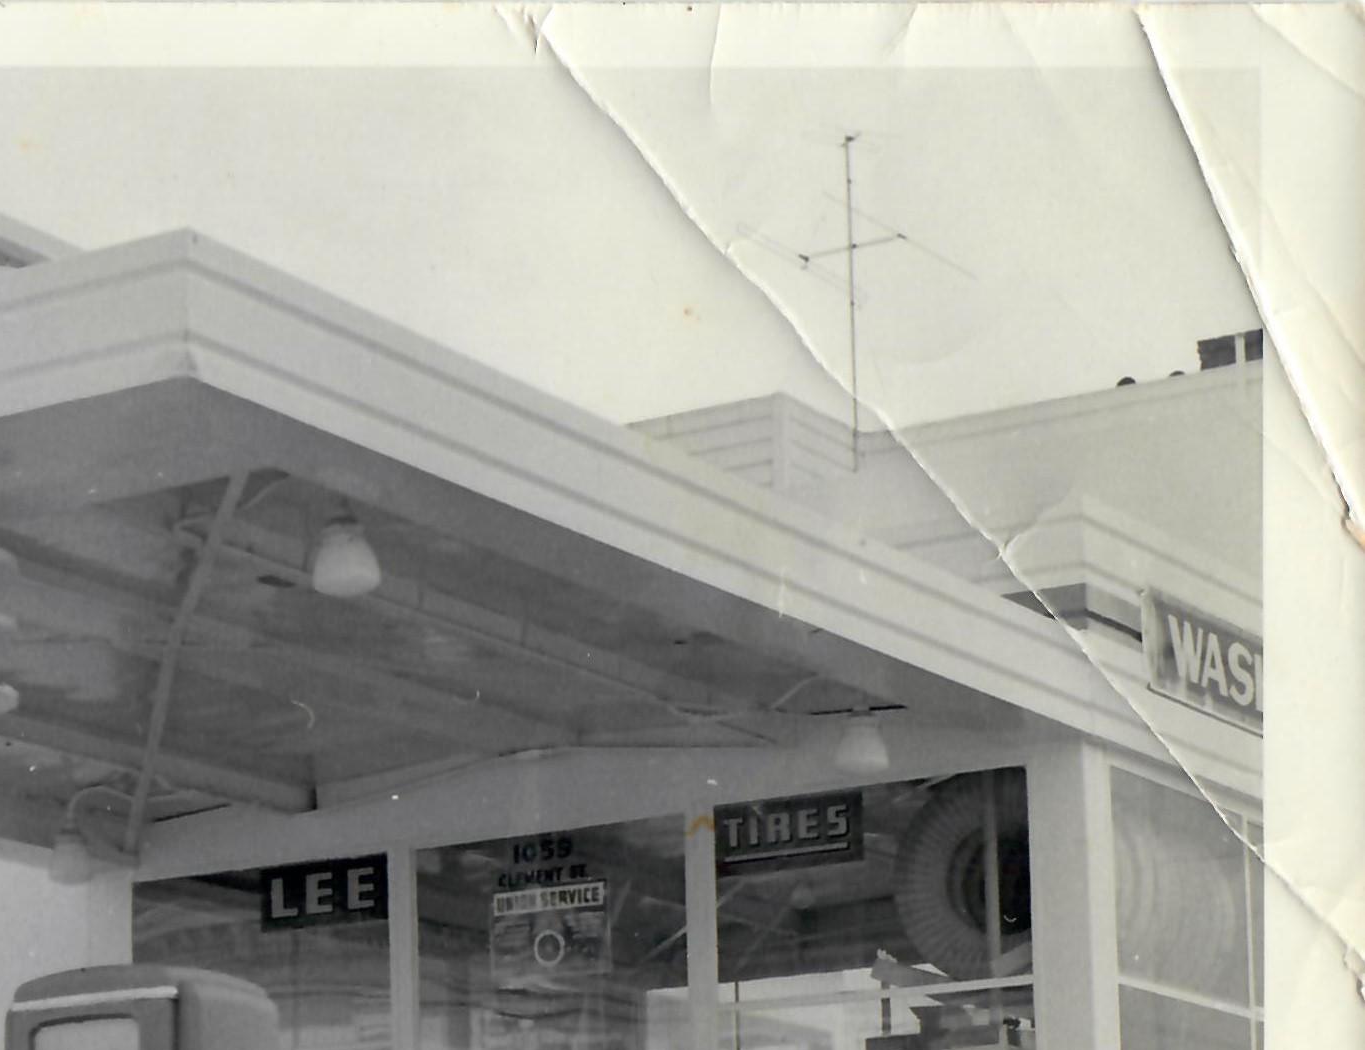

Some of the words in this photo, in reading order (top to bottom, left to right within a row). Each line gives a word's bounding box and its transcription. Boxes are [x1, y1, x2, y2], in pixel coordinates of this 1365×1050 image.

[723, 805, 848, 848] TIRES
[271, 866, 375, 919] LEE
[539, 886, 601, 908] SERVICE
